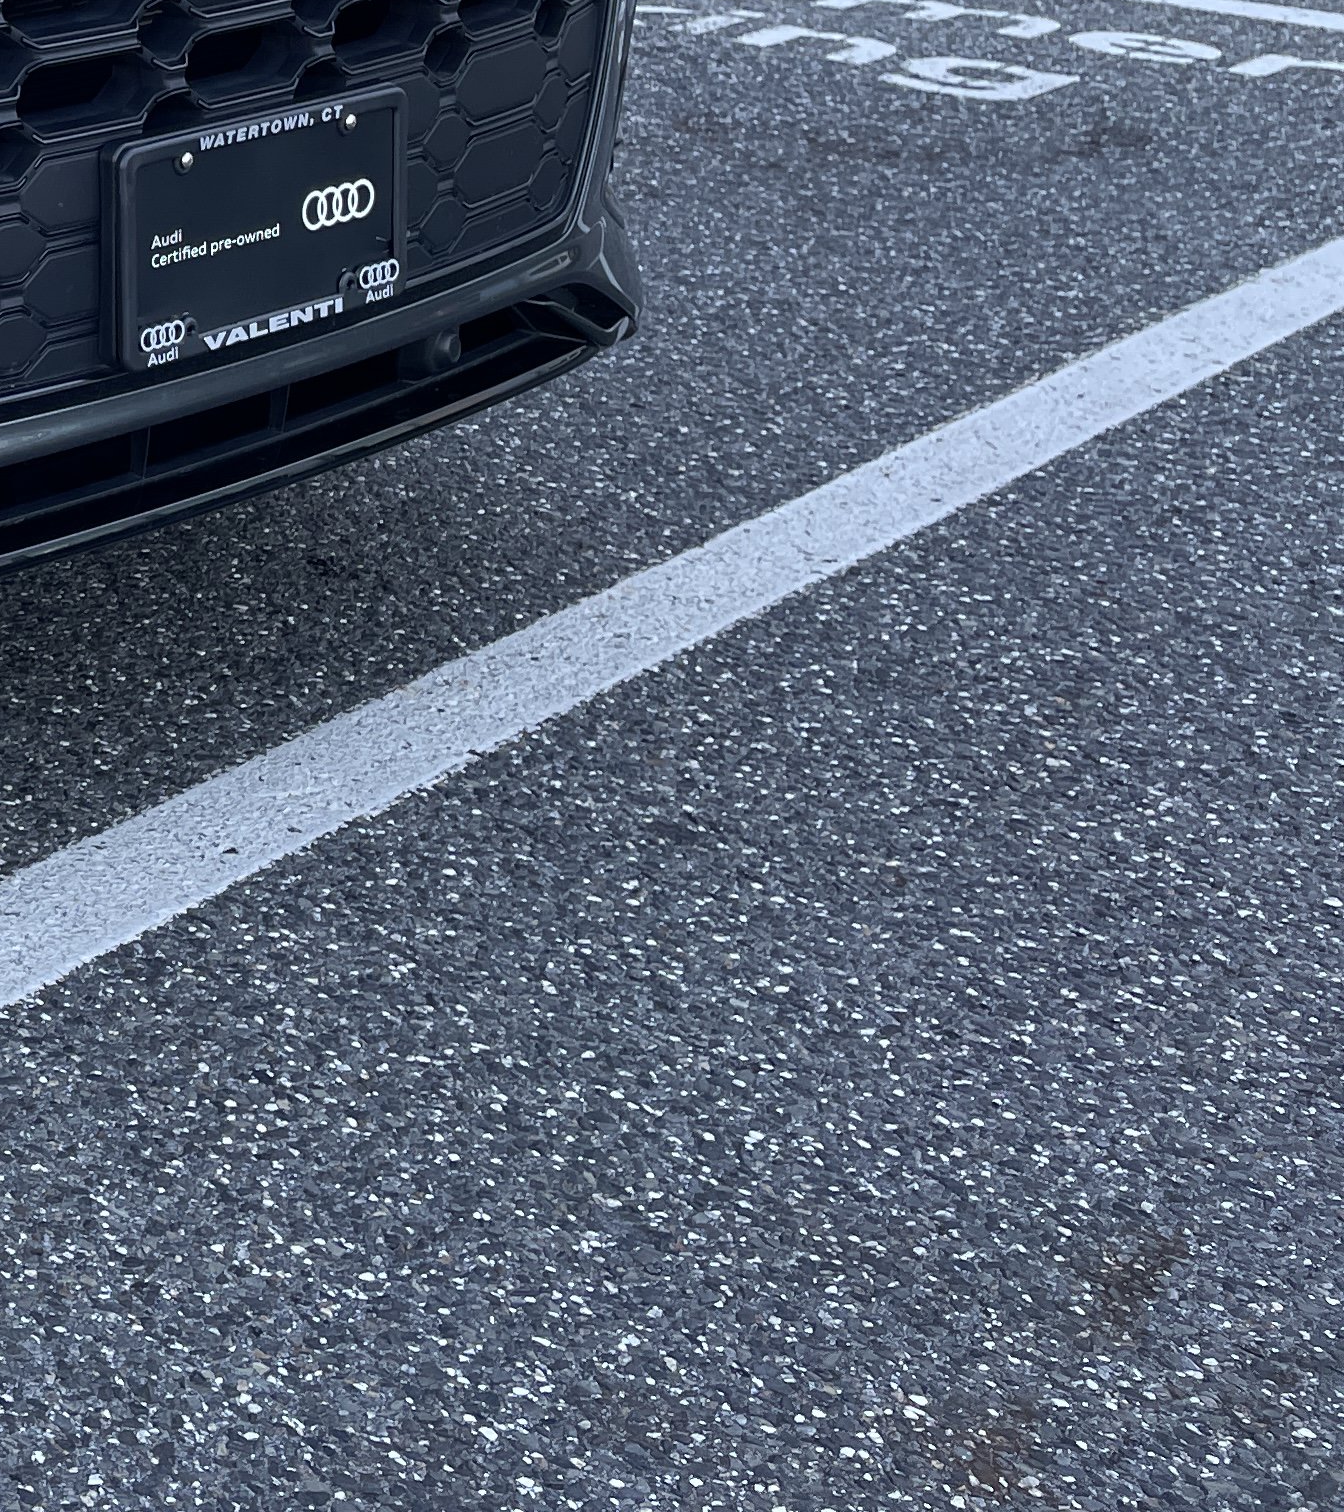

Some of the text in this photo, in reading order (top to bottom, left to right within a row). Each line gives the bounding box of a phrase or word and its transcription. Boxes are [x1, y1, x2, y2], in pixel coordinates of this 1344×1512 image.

[634, 3, 1080, 101] ing
[199, 104, 344, 151] WATERTOWN, CT
[150, 228, 183, 251] Audi
[150, 222, 281, 269] Certified pre-owned
[365, 284, 394, 305] Audi
[202, 297, 345, 352] VALENTI
[146, 347, 179, 369] Audi
